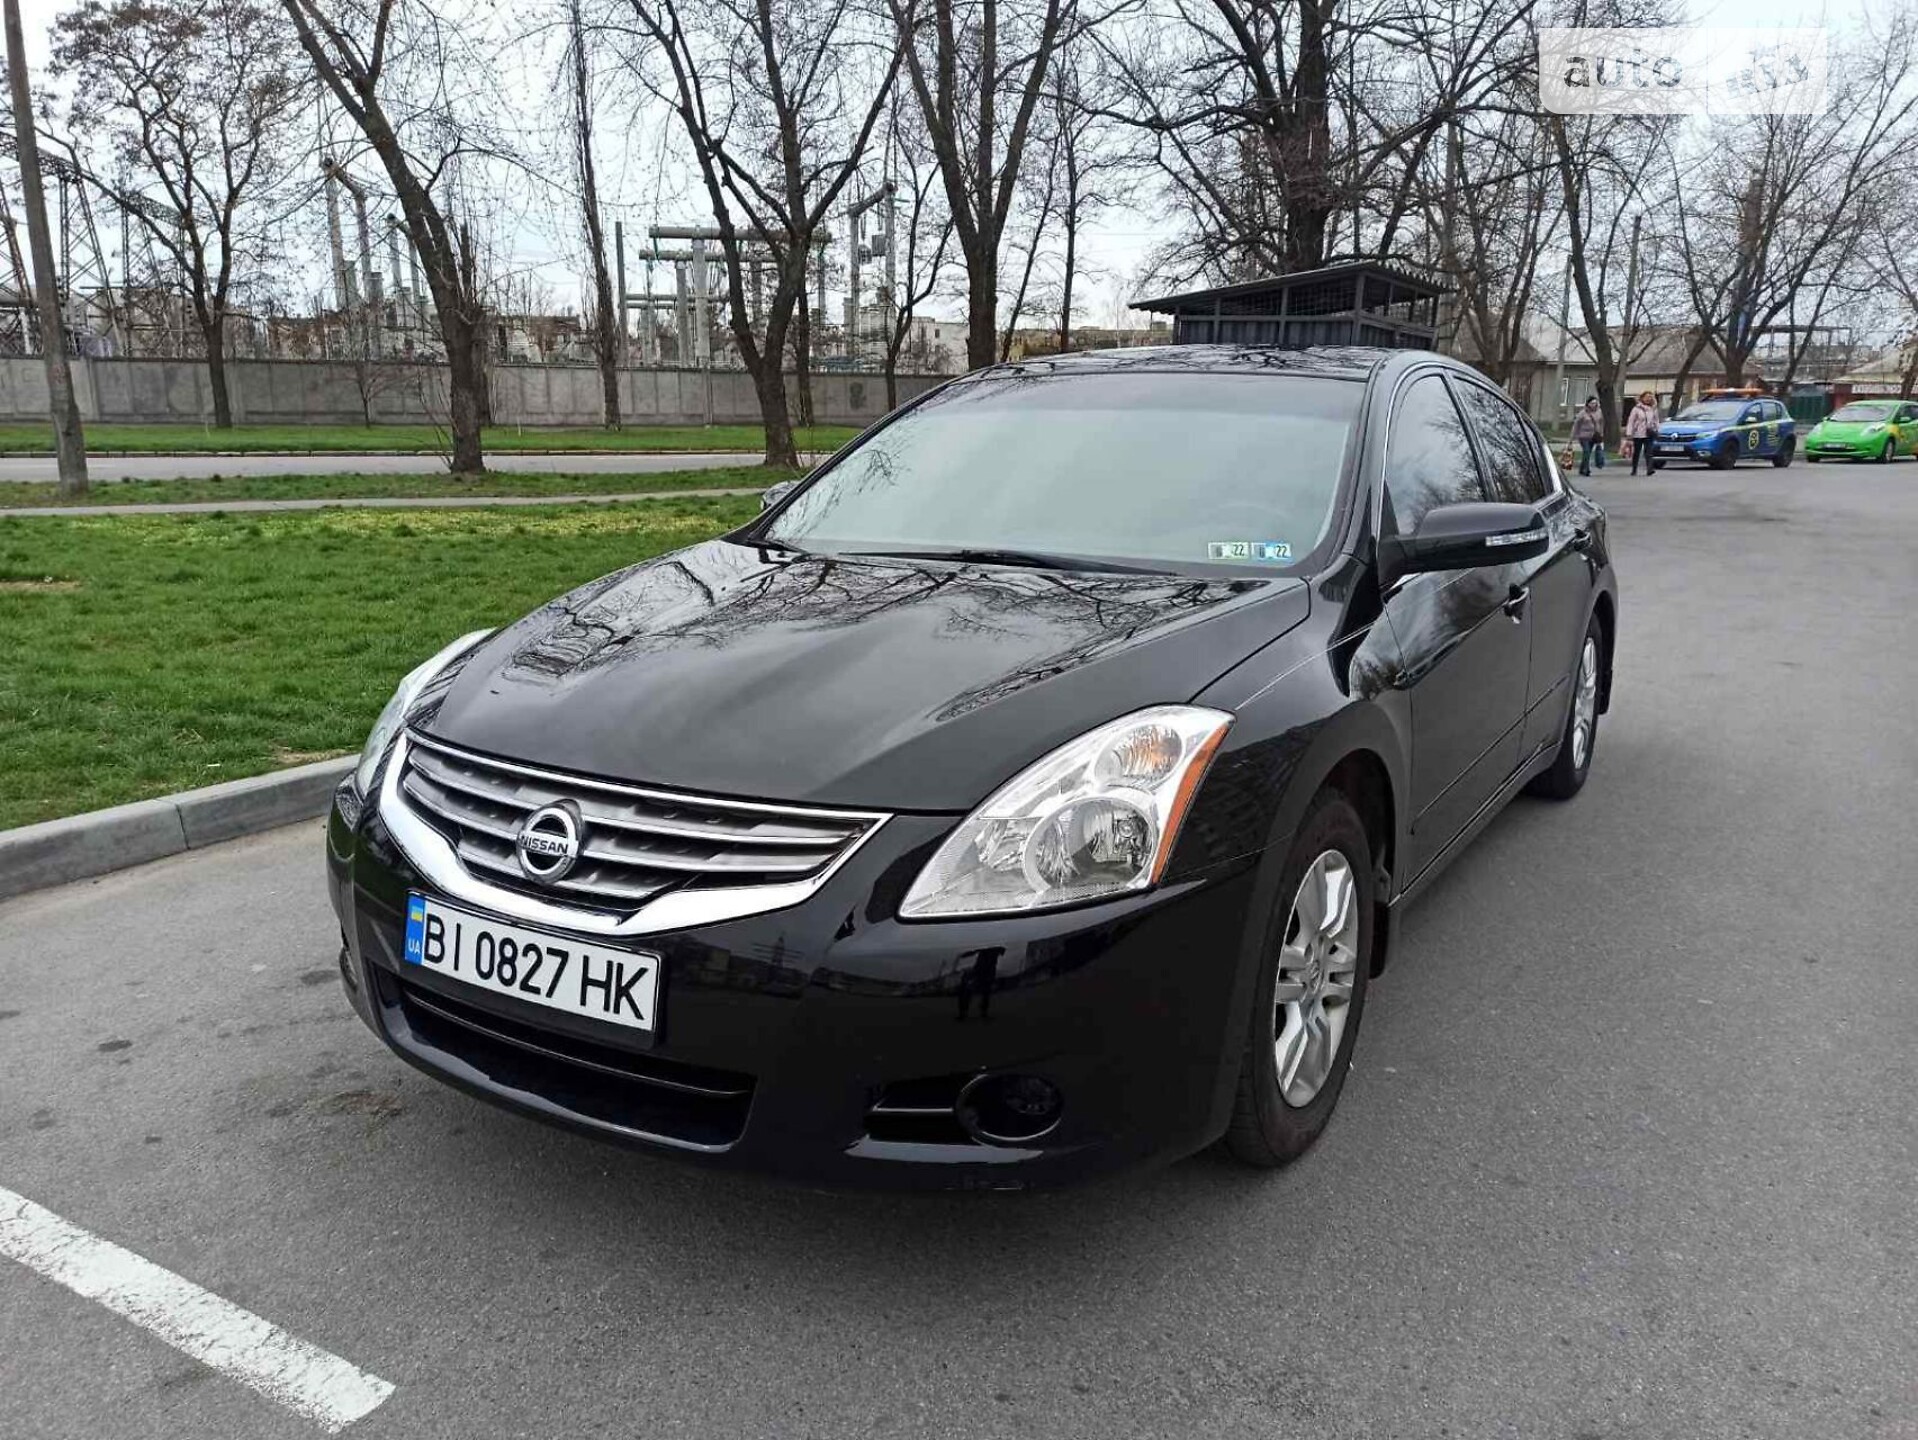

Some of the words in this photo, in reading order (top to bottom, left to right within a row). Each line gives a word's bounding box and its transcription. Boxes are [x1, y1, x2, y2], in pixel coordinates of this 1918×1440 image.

[1233, 544, 1245, 556] 22
[1275, 545, 1287, 558] 22
[520, 834, 568, 855] NISSAN
[408, 938, 421, 955] UA
[424, 913, 462, 972] BI
[475, 930, 569, 999] 0827
[579, 954, 648, 1020] HK
